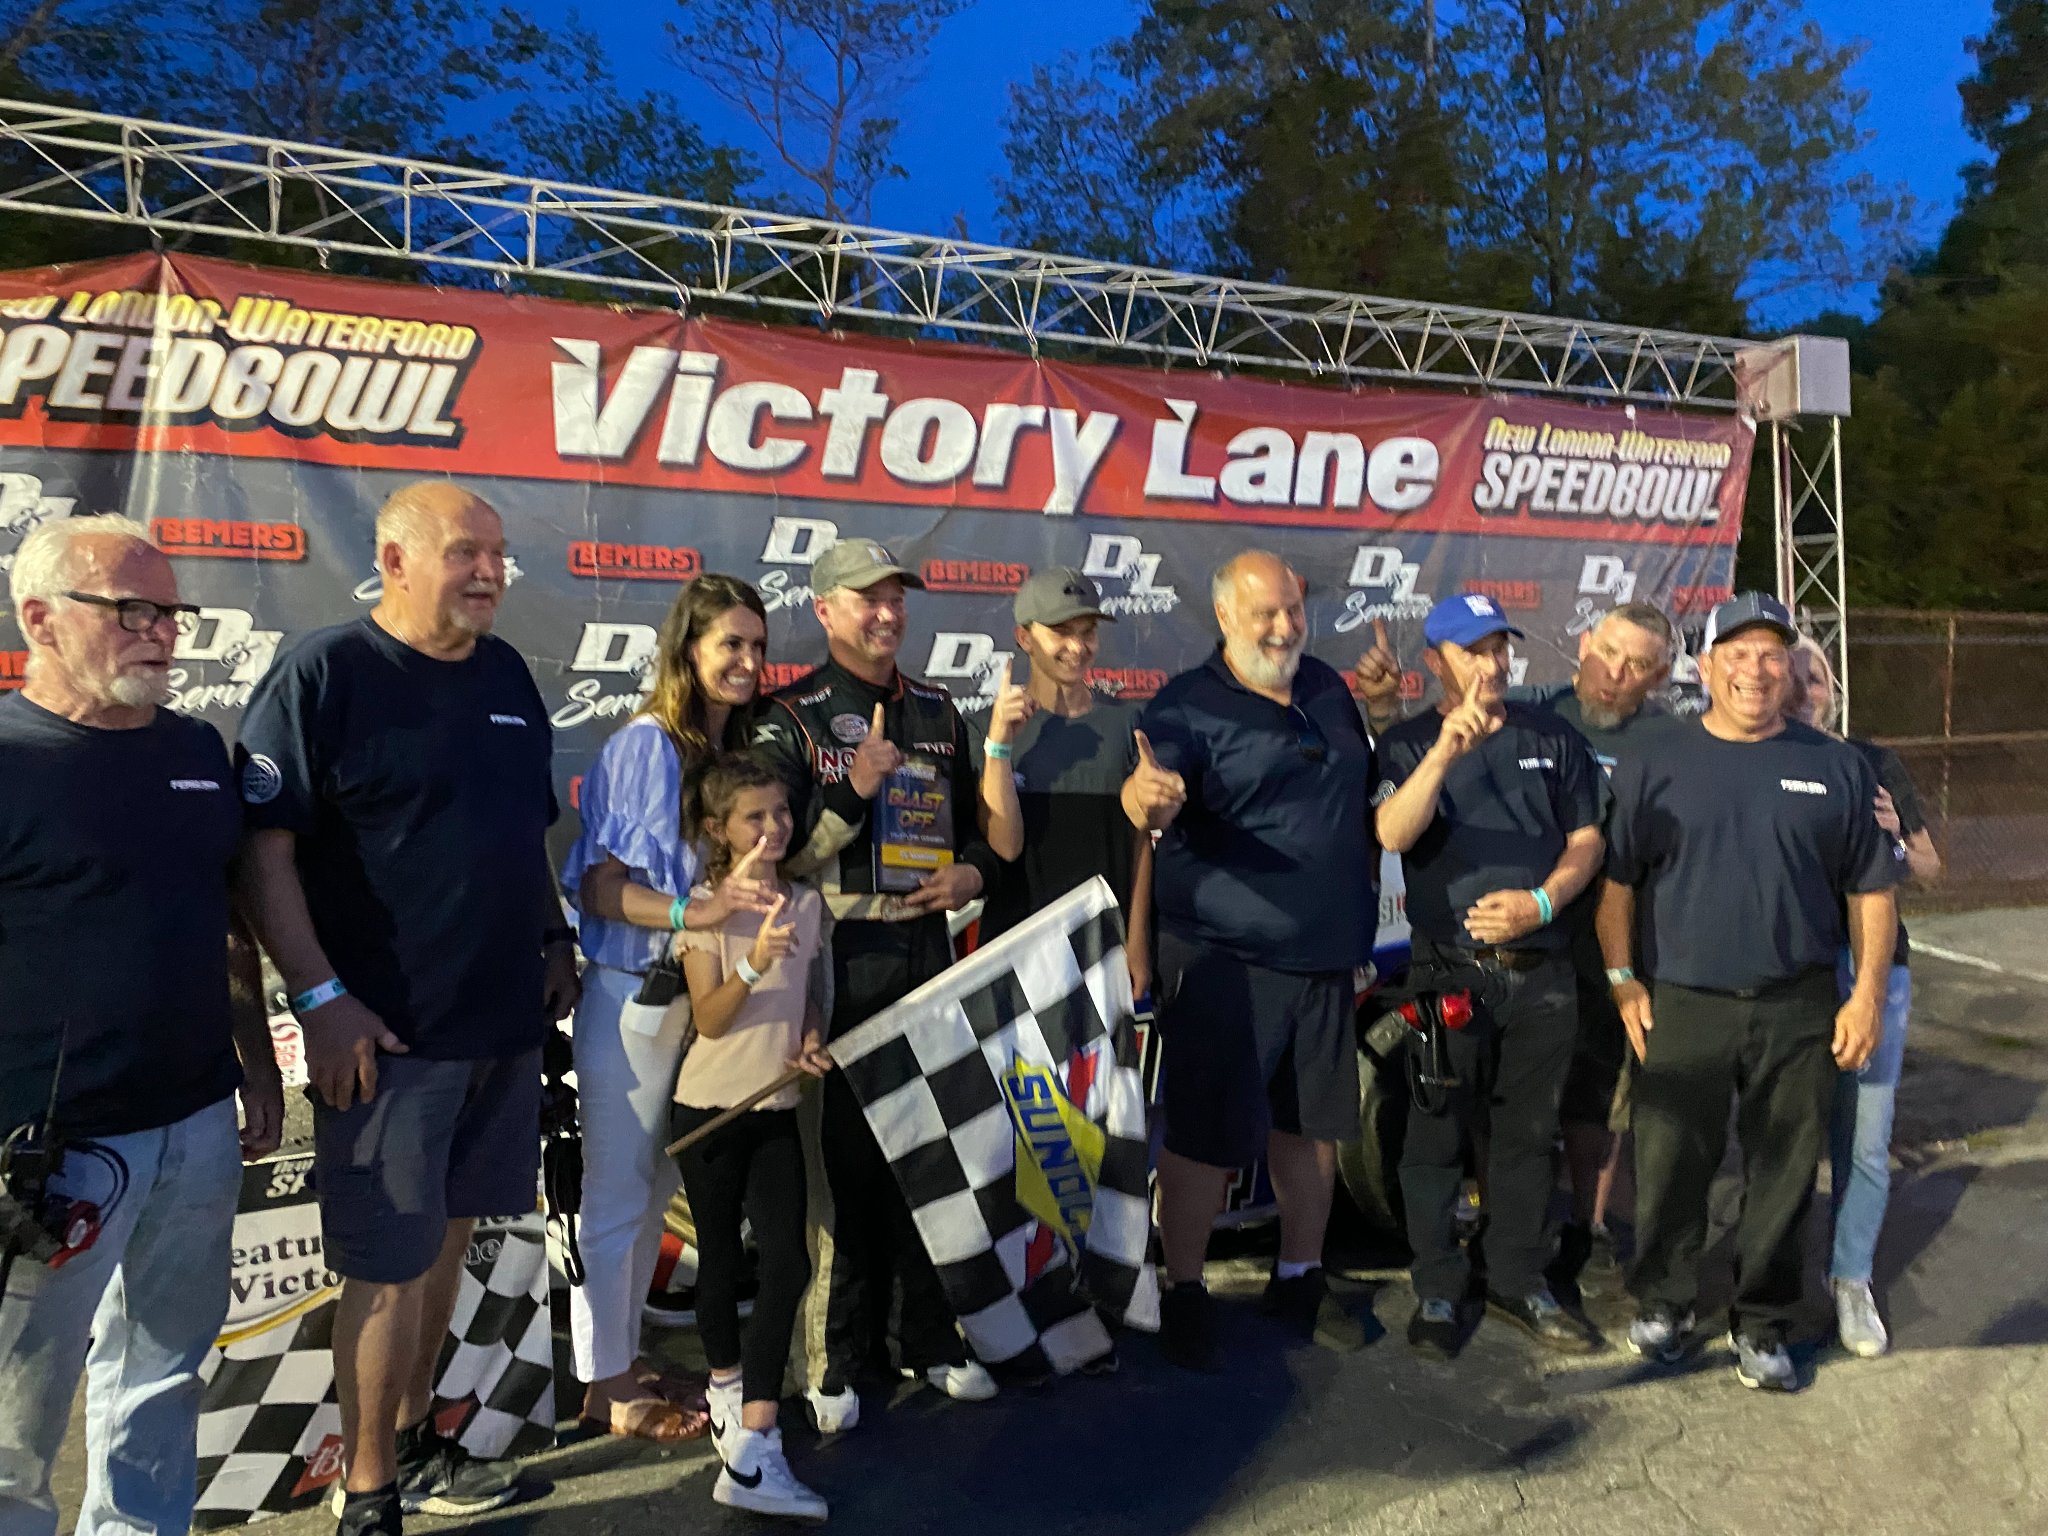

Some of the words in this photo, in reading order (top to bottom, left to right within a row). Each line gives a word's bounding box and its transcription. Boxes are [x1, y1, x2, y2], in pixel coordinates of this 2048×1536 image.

[0, 323, 457, 437] PEEDBOWL
[551, 337, 1119, 516] Victory
[1143, 398, 1440, 511] Lane
[1474, 452, 1722, 521] SPEEDBOWL
[160, 518, 293, 550] BEMERS
[579, 541, 693, 571] BEMERS
[929, 560, 1022, 585] BEMERS
[230, 1266, 338, 1304] Victo
